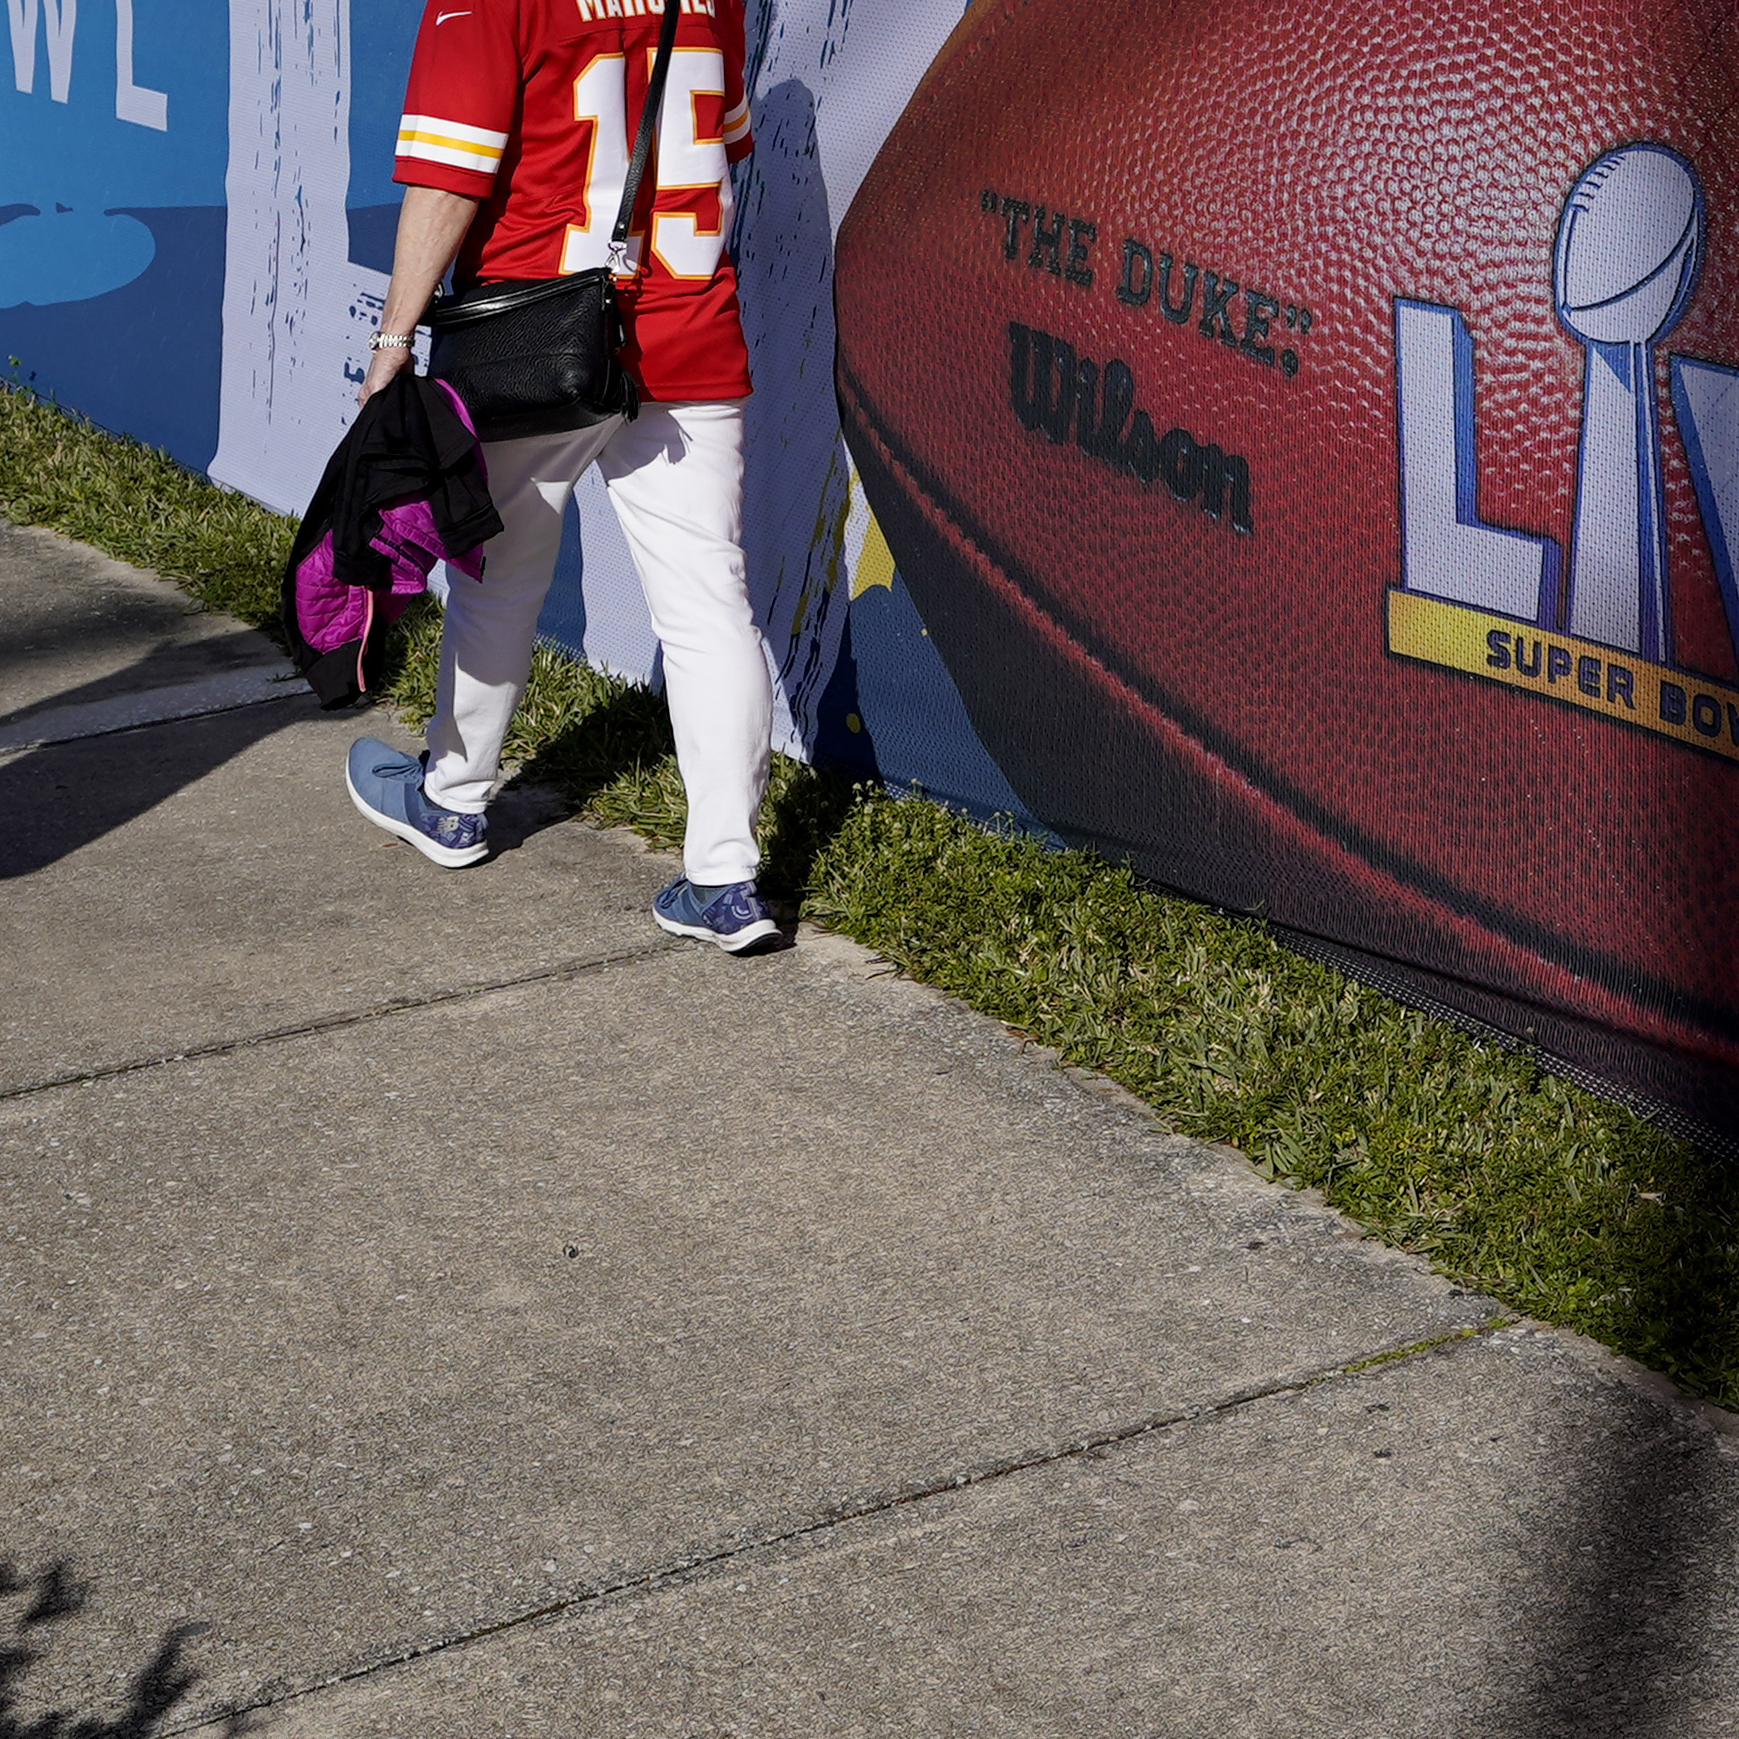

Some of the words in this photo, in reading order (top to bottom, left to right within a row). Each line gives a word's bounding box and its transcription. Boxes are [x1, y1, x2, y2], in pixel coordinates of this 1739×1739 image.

[558, 45, 735, 281] 15
[1008, 320, 1254, 536] Wilson
[1484, 628, 1636, 712] SUPER
